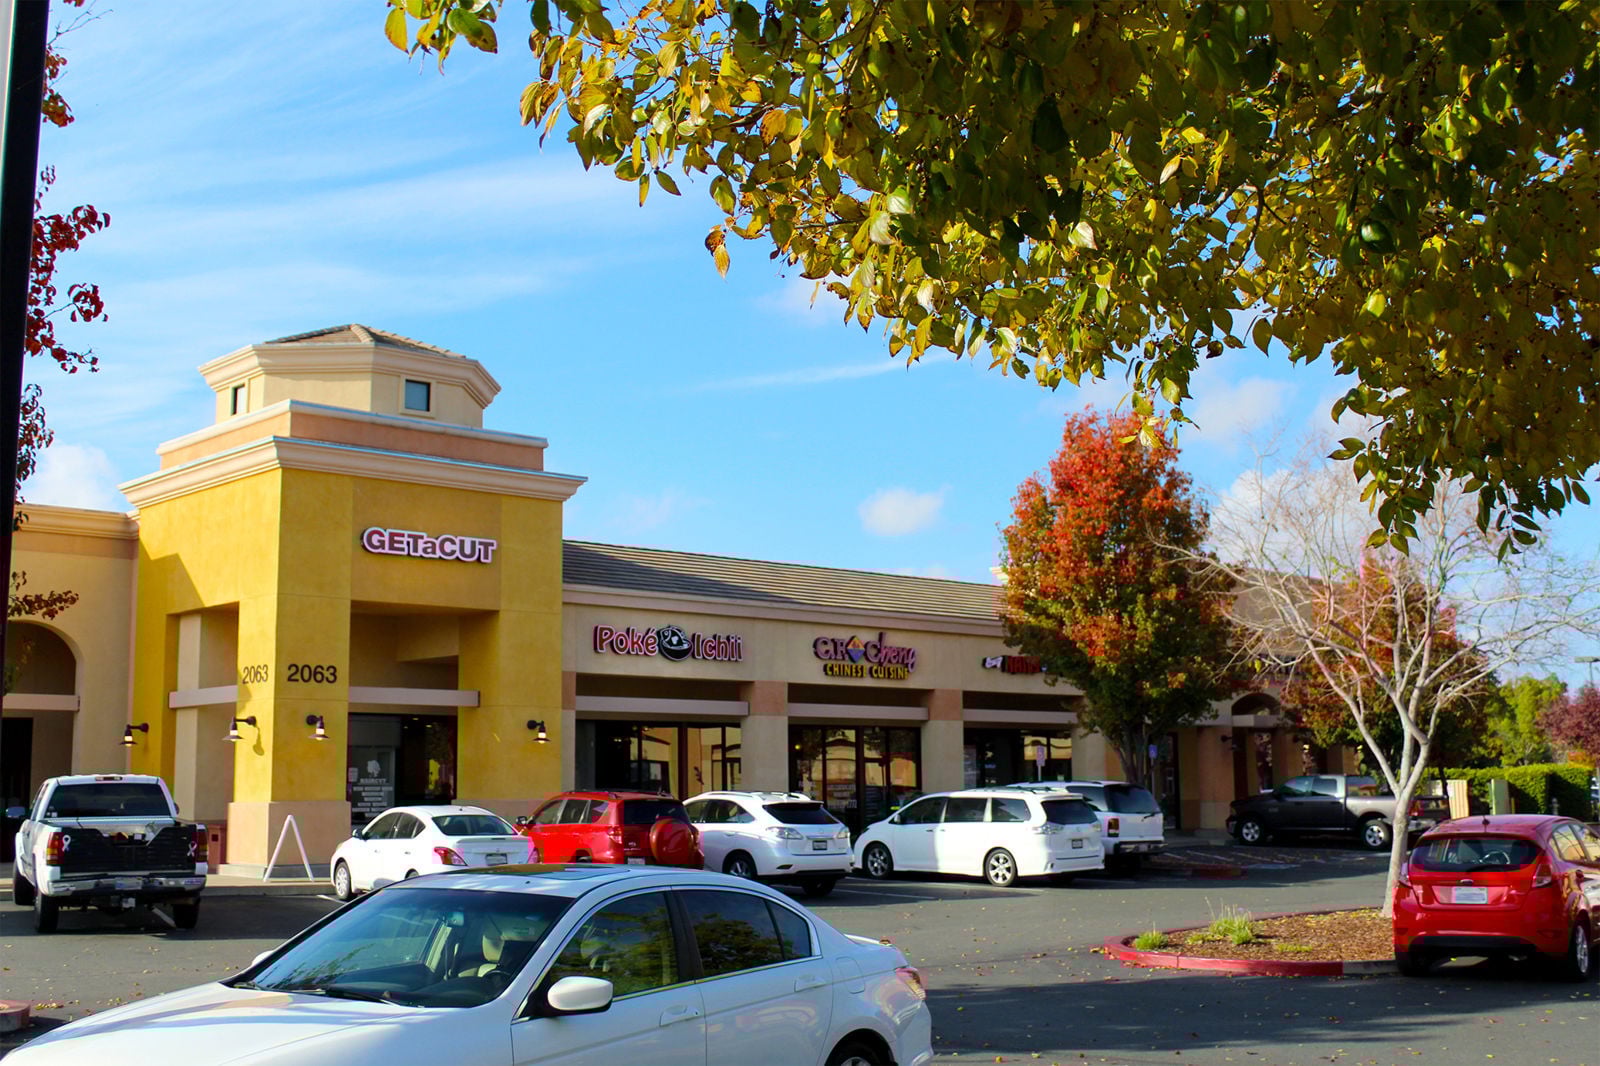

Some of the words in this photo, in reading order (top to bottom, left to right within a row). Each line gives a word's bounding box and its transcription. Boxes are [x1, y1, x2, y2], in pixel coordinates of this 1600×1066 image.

[362, 527, 497, 563] GETaCUT
[594, 624, 659, 656] Poké
[693, 632, 744, 661] Ichii
[242, 664, 269, 685] 2063
[287, 663, 338, 684] 2063
[825, 663, 867, 677] CHINESE
[870, 665, 909, 680] CUISINE
